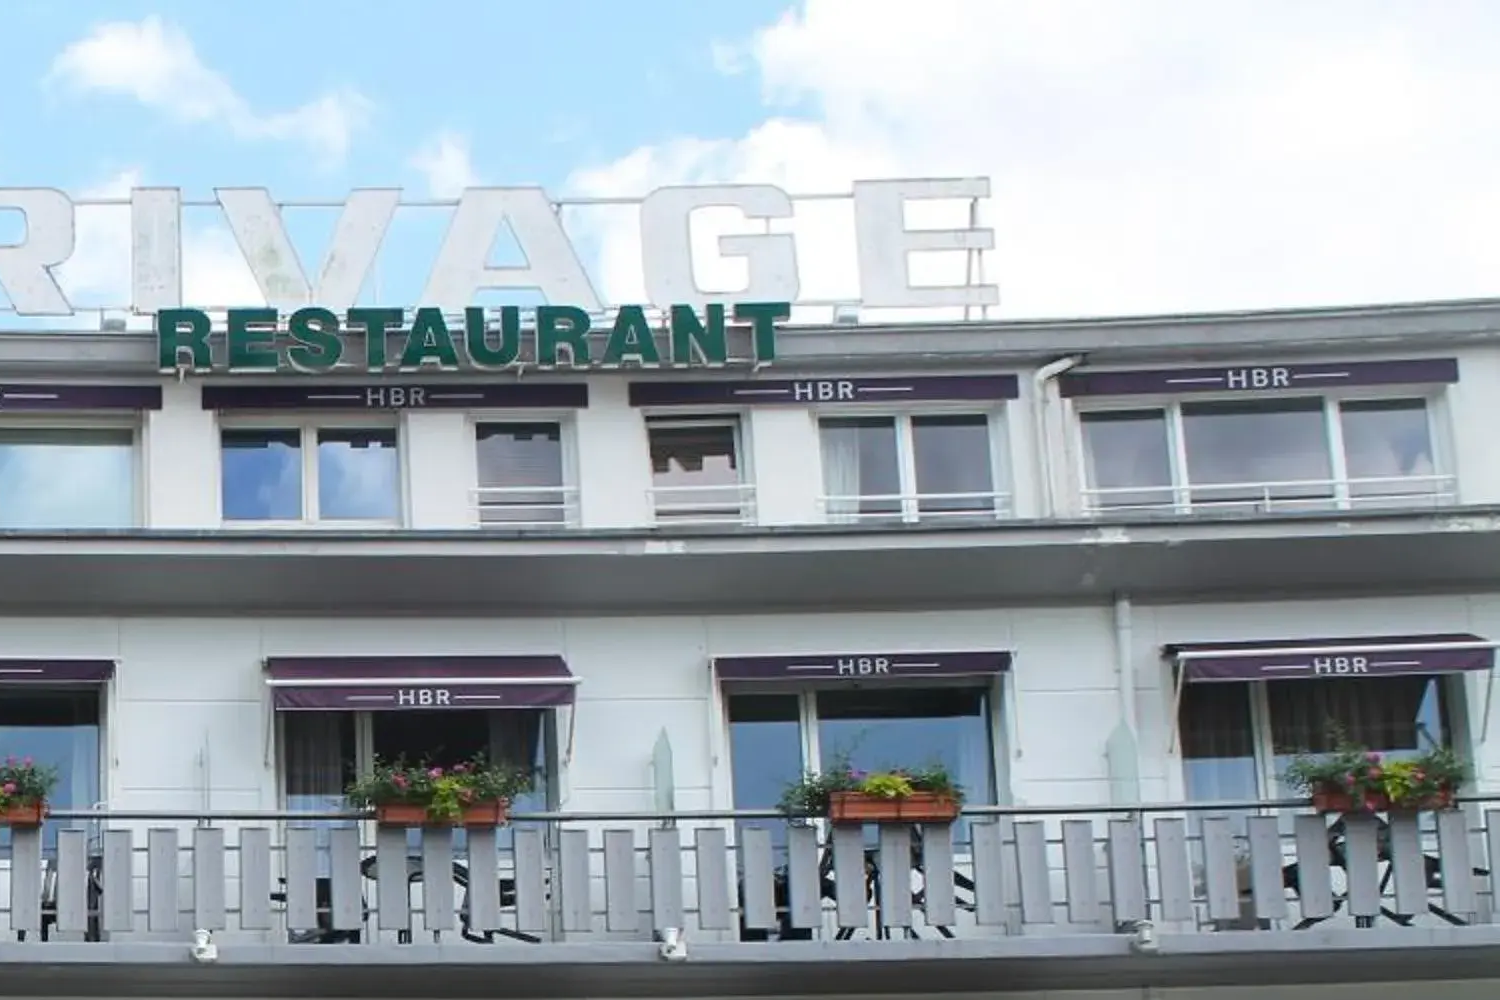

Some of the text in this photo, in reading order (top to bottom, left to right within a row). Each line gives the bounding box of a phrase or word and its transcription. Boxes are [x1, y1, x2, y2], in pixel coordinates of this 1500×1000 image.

[156, 302, 792, 374] RESTAURANT
[1227, 367, 1289, 389] HBR
[366, 387, 425, 407] HBR
[794, 381, 854, 401] HBR
[838, 656, 889, 675] HBR
[1313, 656, 1368, 675] HBR
[398, 688, 450, 705] HBR
